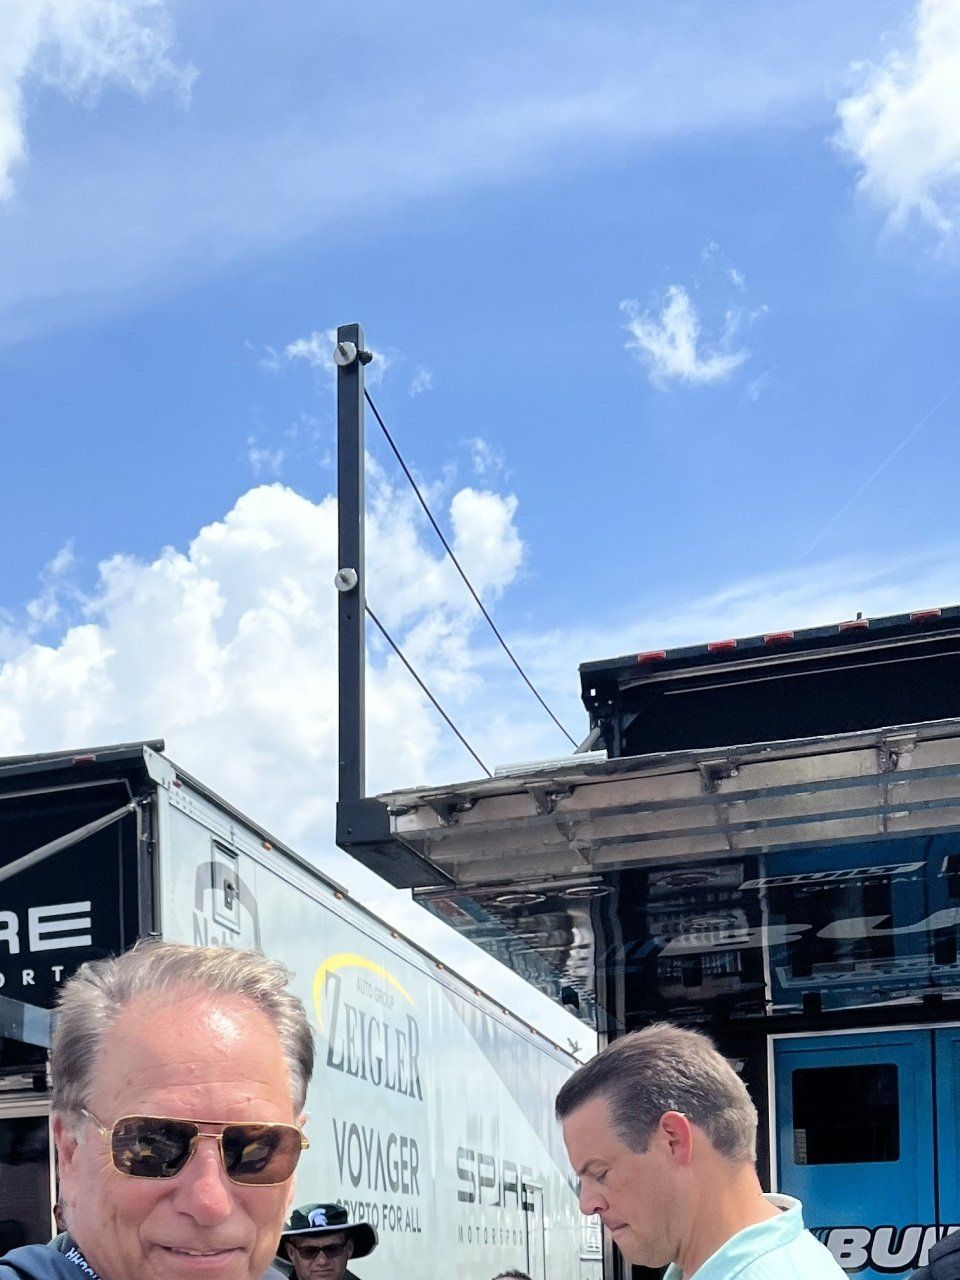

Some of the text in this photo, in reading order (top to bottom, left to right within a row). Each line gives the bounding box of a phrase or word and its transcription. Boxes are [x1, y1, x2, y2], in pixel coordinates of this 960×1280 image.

[326, 969, 423, 1101] ZEIGLER
[332, 1118, 420, 1196] VOYAGER
[456, 1146, 534, 1212] SPIRE
[382, 1204, 403, 1232] FOR
[405, 1206, 422, 1232] ALL
[458, 1225, 524, 1247] MOTORSPOR
